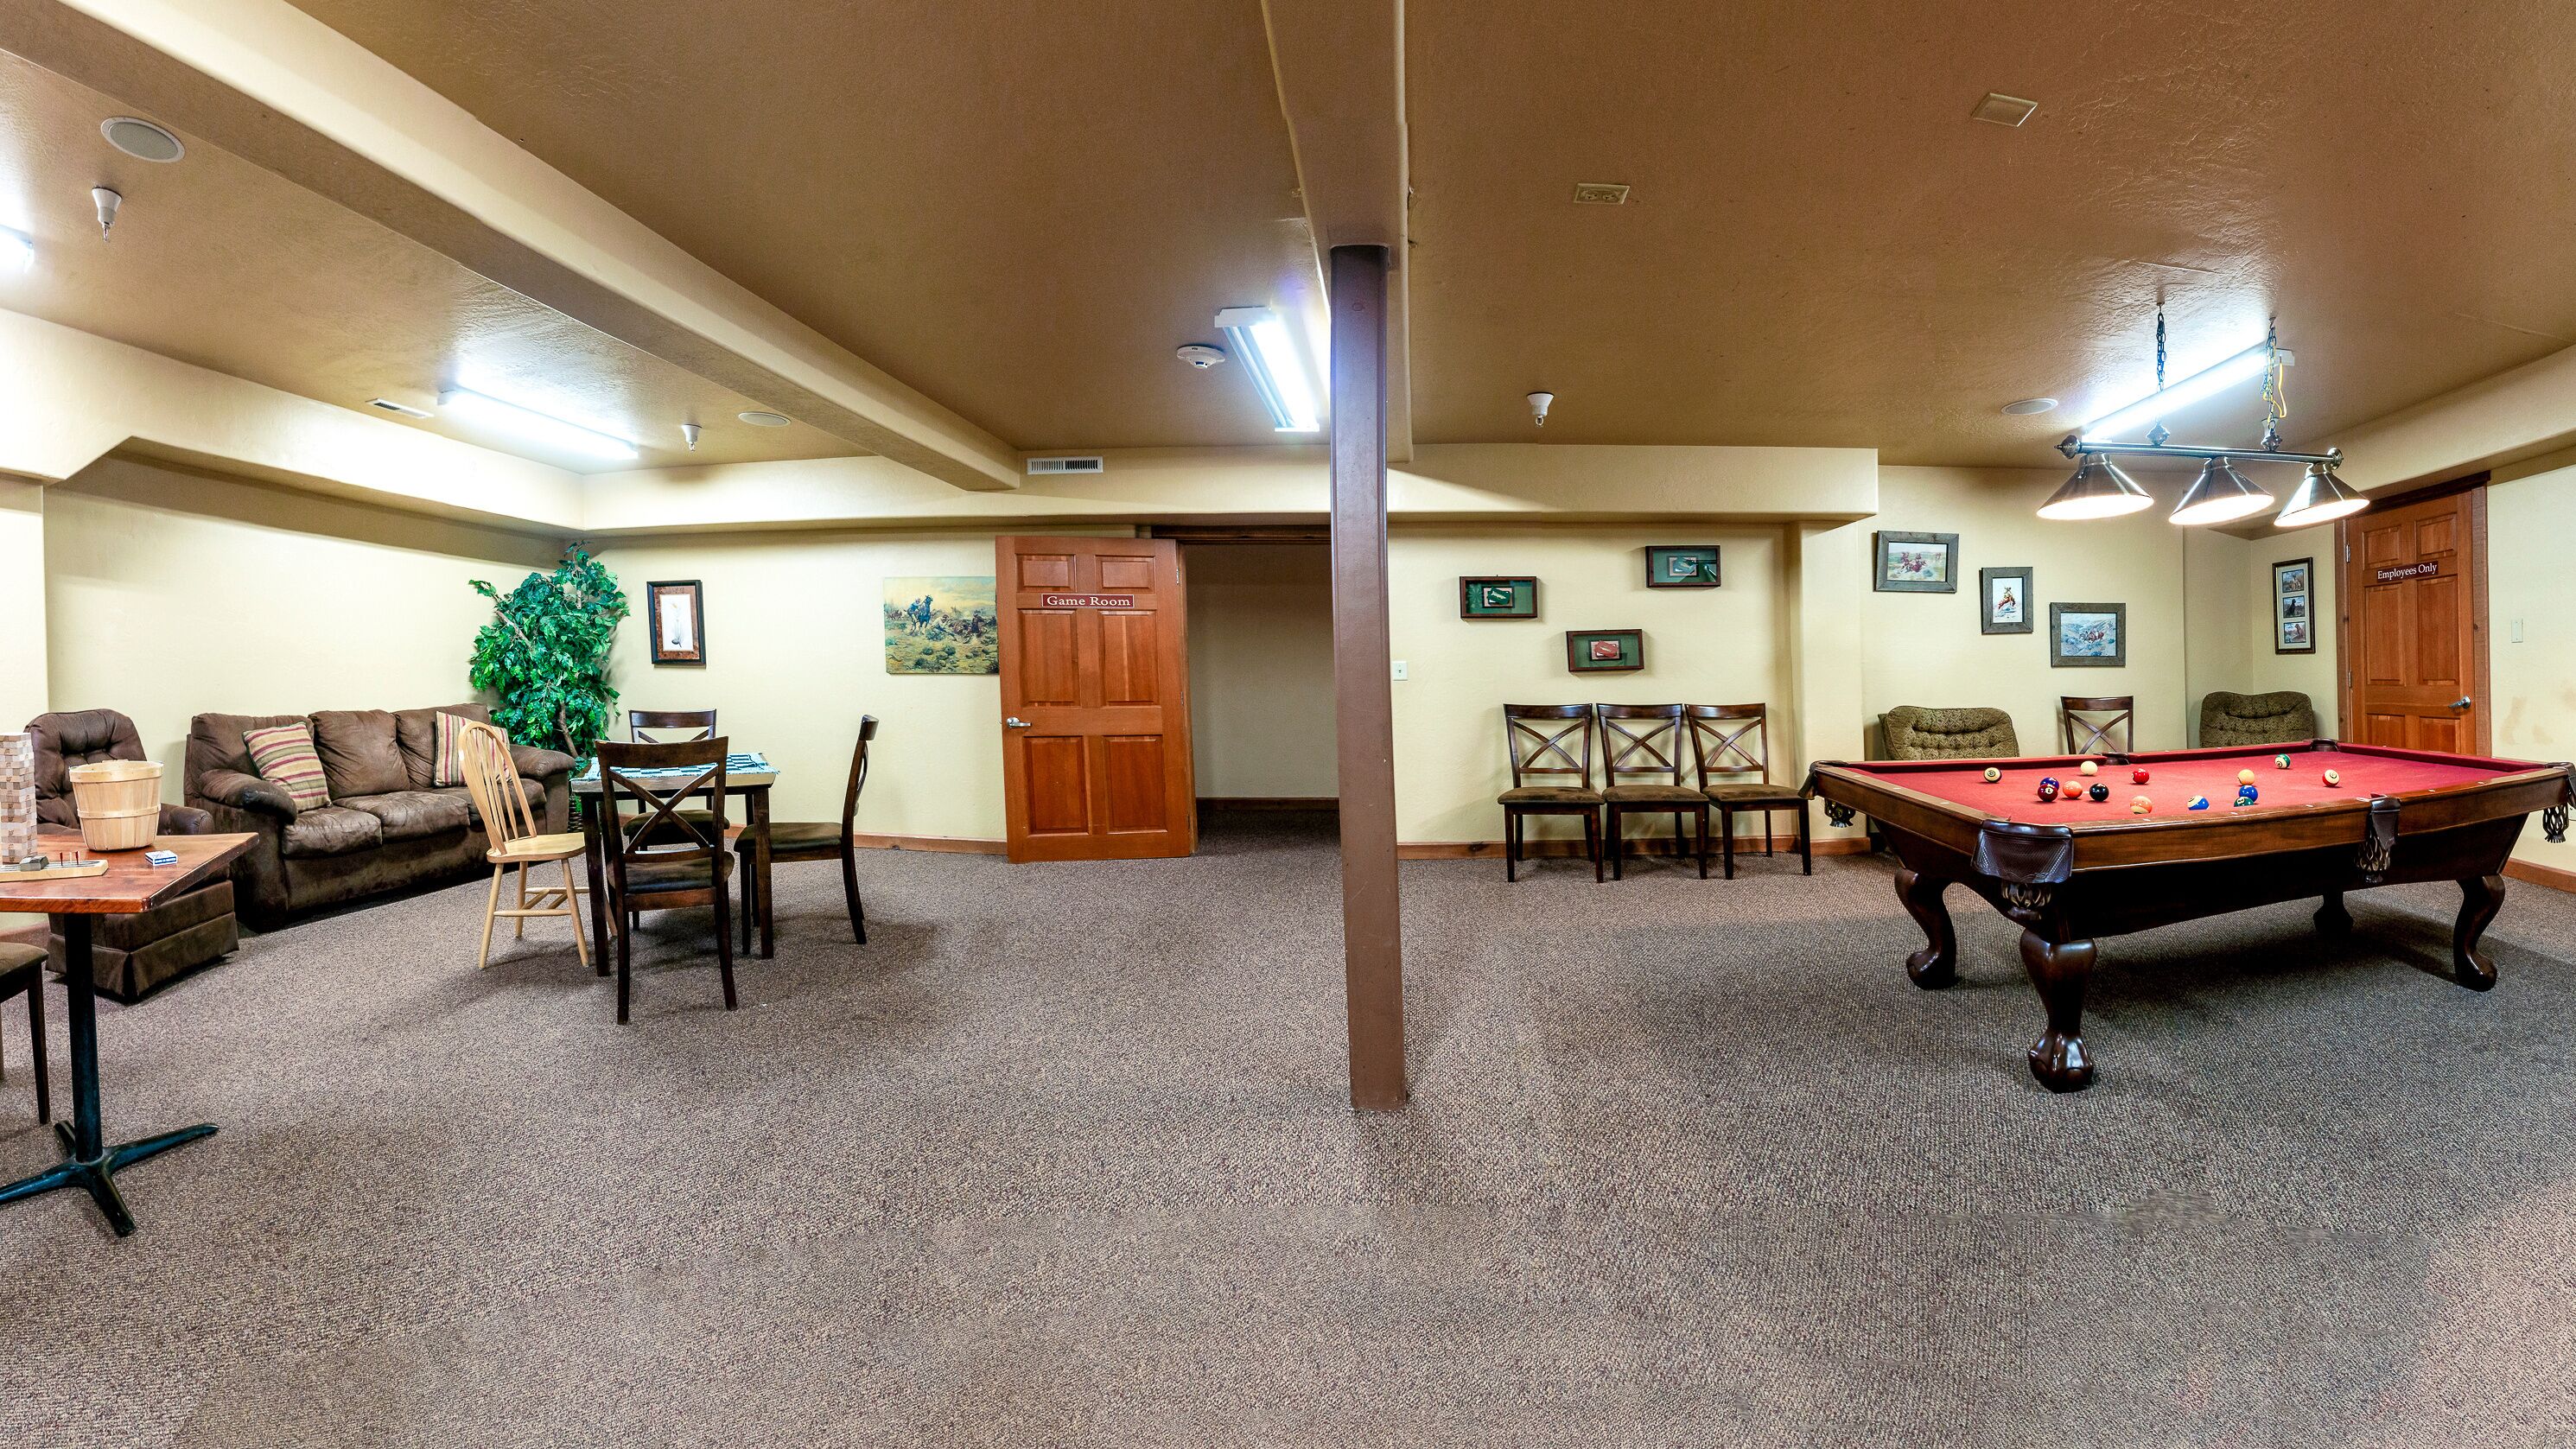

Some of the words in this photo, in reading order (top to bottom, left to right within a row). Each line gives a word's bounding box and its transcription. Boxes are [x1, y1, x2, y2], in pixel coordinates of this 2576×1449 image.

[2377, 568, 2417, 580] Employees
[2418, 562, 2437, 575] Only
[1046, 595, 1085, 606] Game
[1090, 596, 1130, 606] Room
